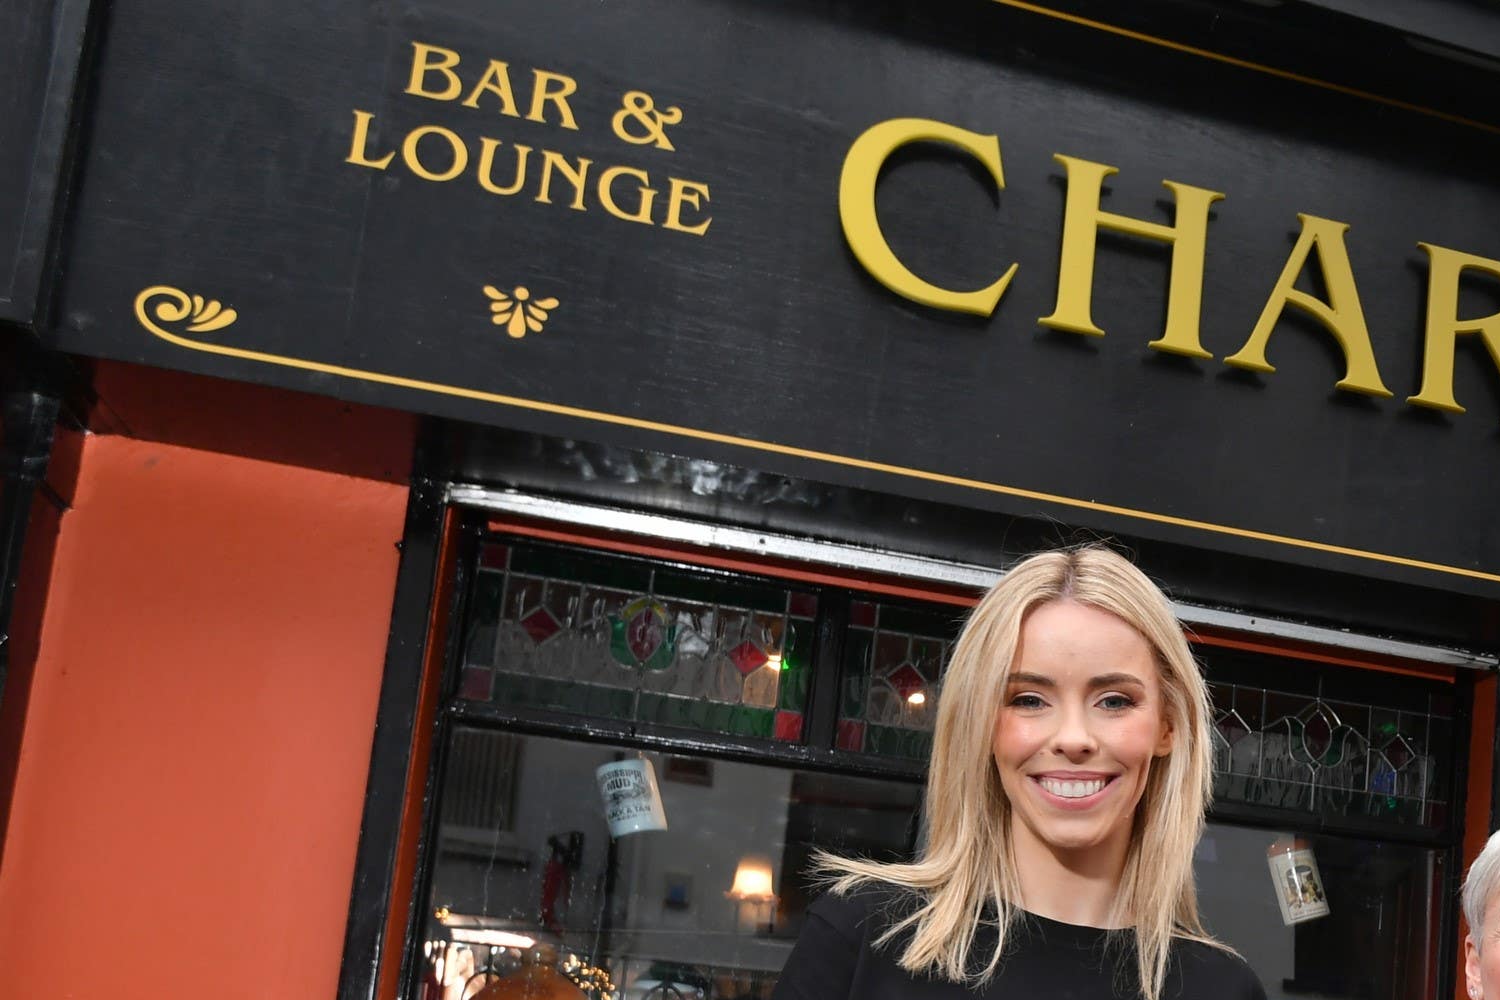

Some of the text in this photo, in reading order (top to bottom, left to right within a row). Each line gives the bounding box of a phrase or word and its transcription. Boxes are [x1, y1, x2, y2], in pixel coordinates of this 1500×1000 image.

[406, 41, 684, 152] BAR &
[346, 110, 712, 237] LOUNGE
[607, 778, 631, 791] MUD
